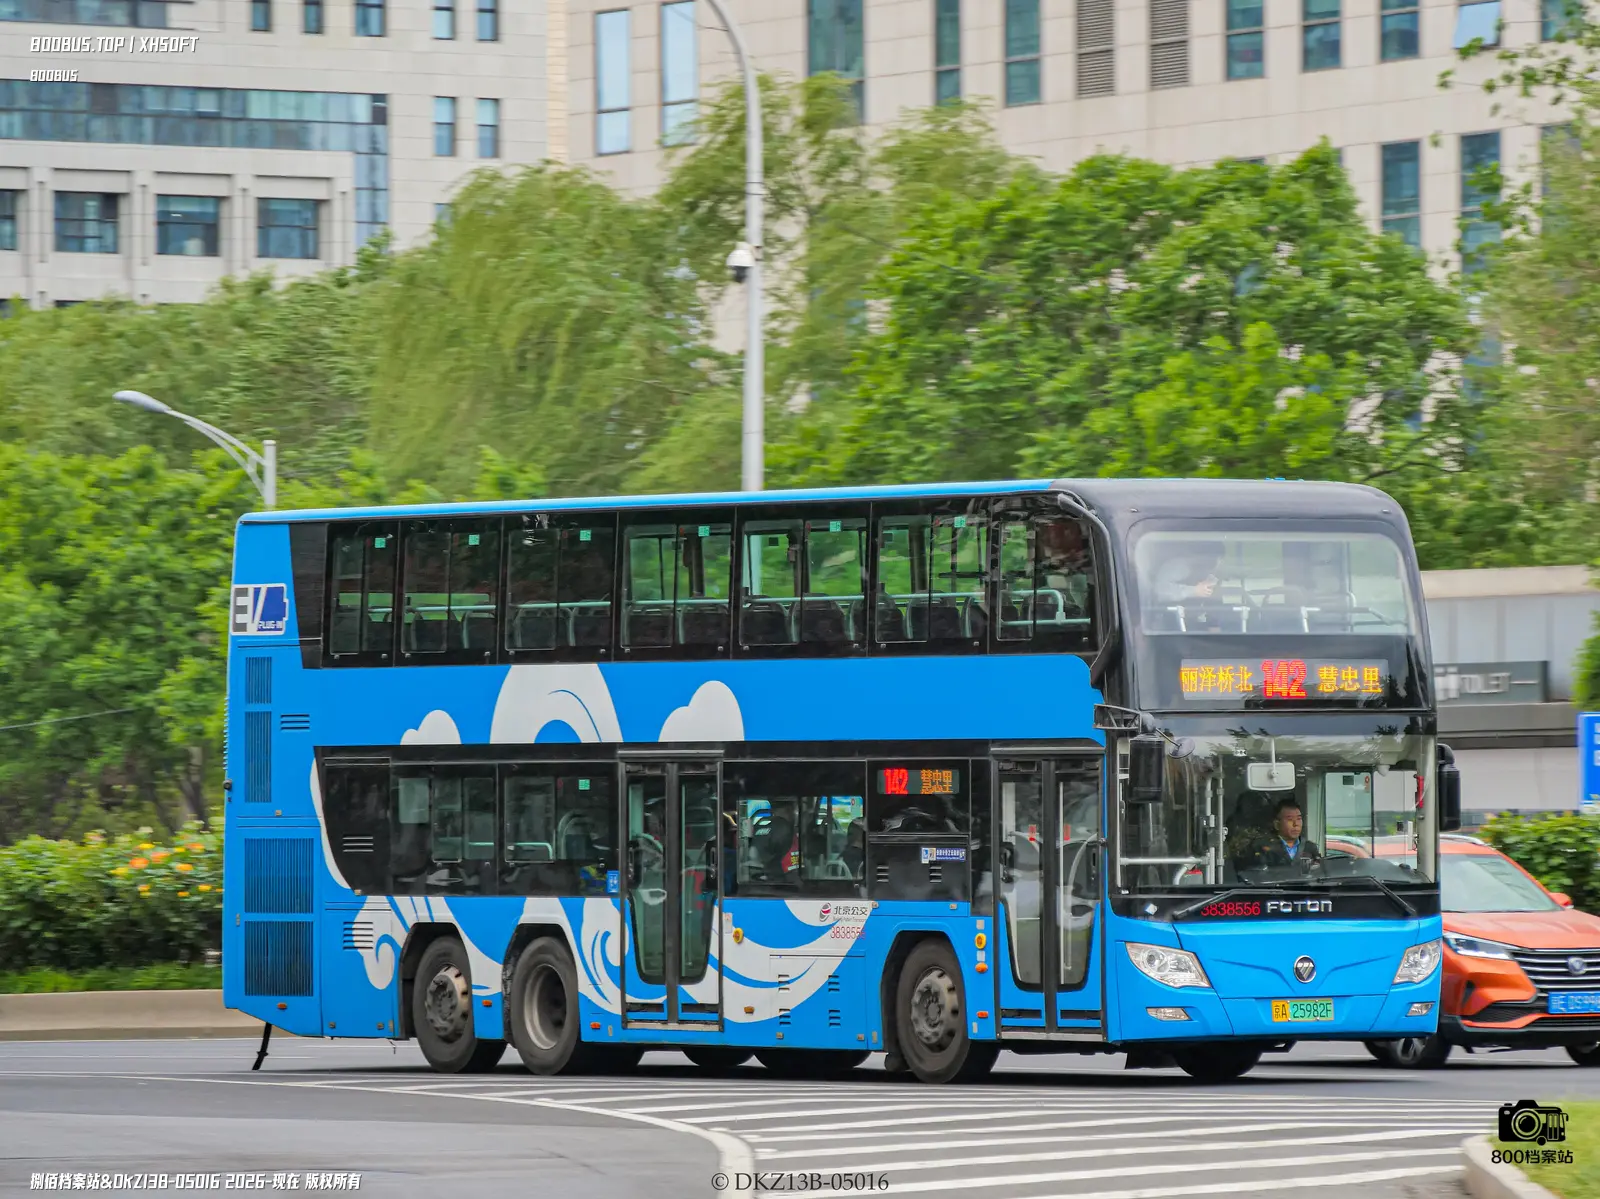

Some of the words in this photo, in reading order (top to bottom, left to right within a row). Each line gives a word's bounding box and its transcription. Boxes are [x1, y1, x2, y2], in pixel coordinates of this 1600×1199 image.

[1180, 665, 1254, 693] 丽泽桥北
[1260, 659, 1308, 699] 142
[1318, 665, 1383, 693] 慧忠里
[883, 768, 909, 795] 142
[920, 769, 953, 795] 慧忠里
[833, 906, 868, 916] 北京公交
[1200, 901, 1261, 916] 3838556
